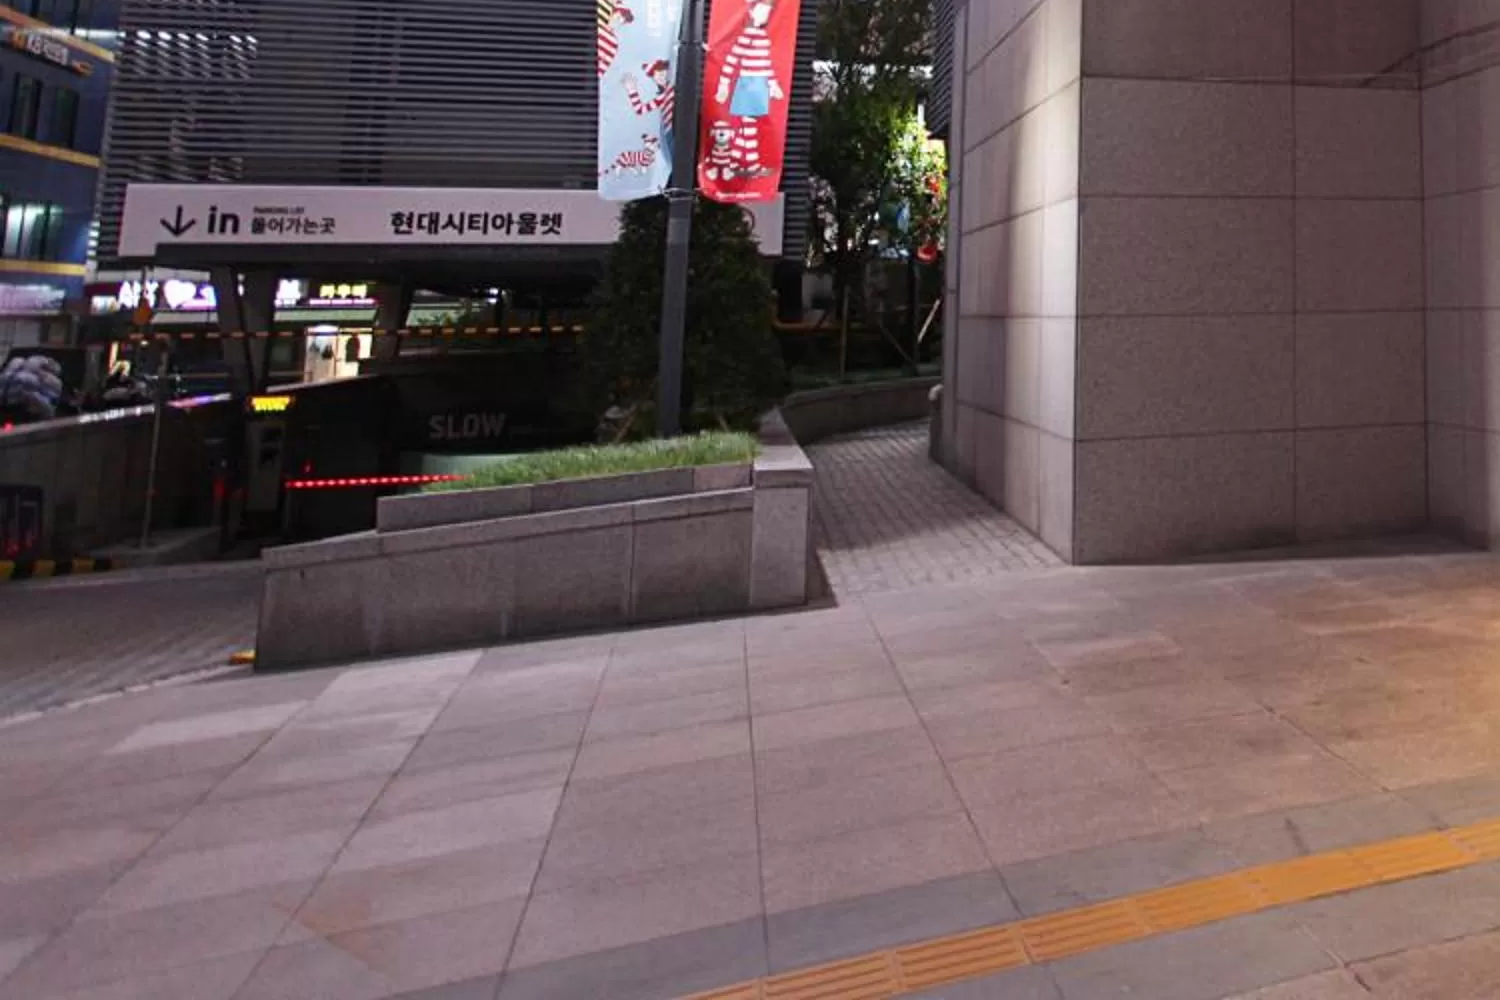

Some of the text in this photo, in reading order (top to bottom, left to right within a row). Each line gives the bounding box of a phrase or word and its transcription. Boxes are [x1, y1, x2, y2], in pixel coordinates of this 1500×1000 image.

[207, 205, 240, 235] in
[391, 211, 563, 235] 현대시티아울렛
[428, 413, 506, 440] SLOW
